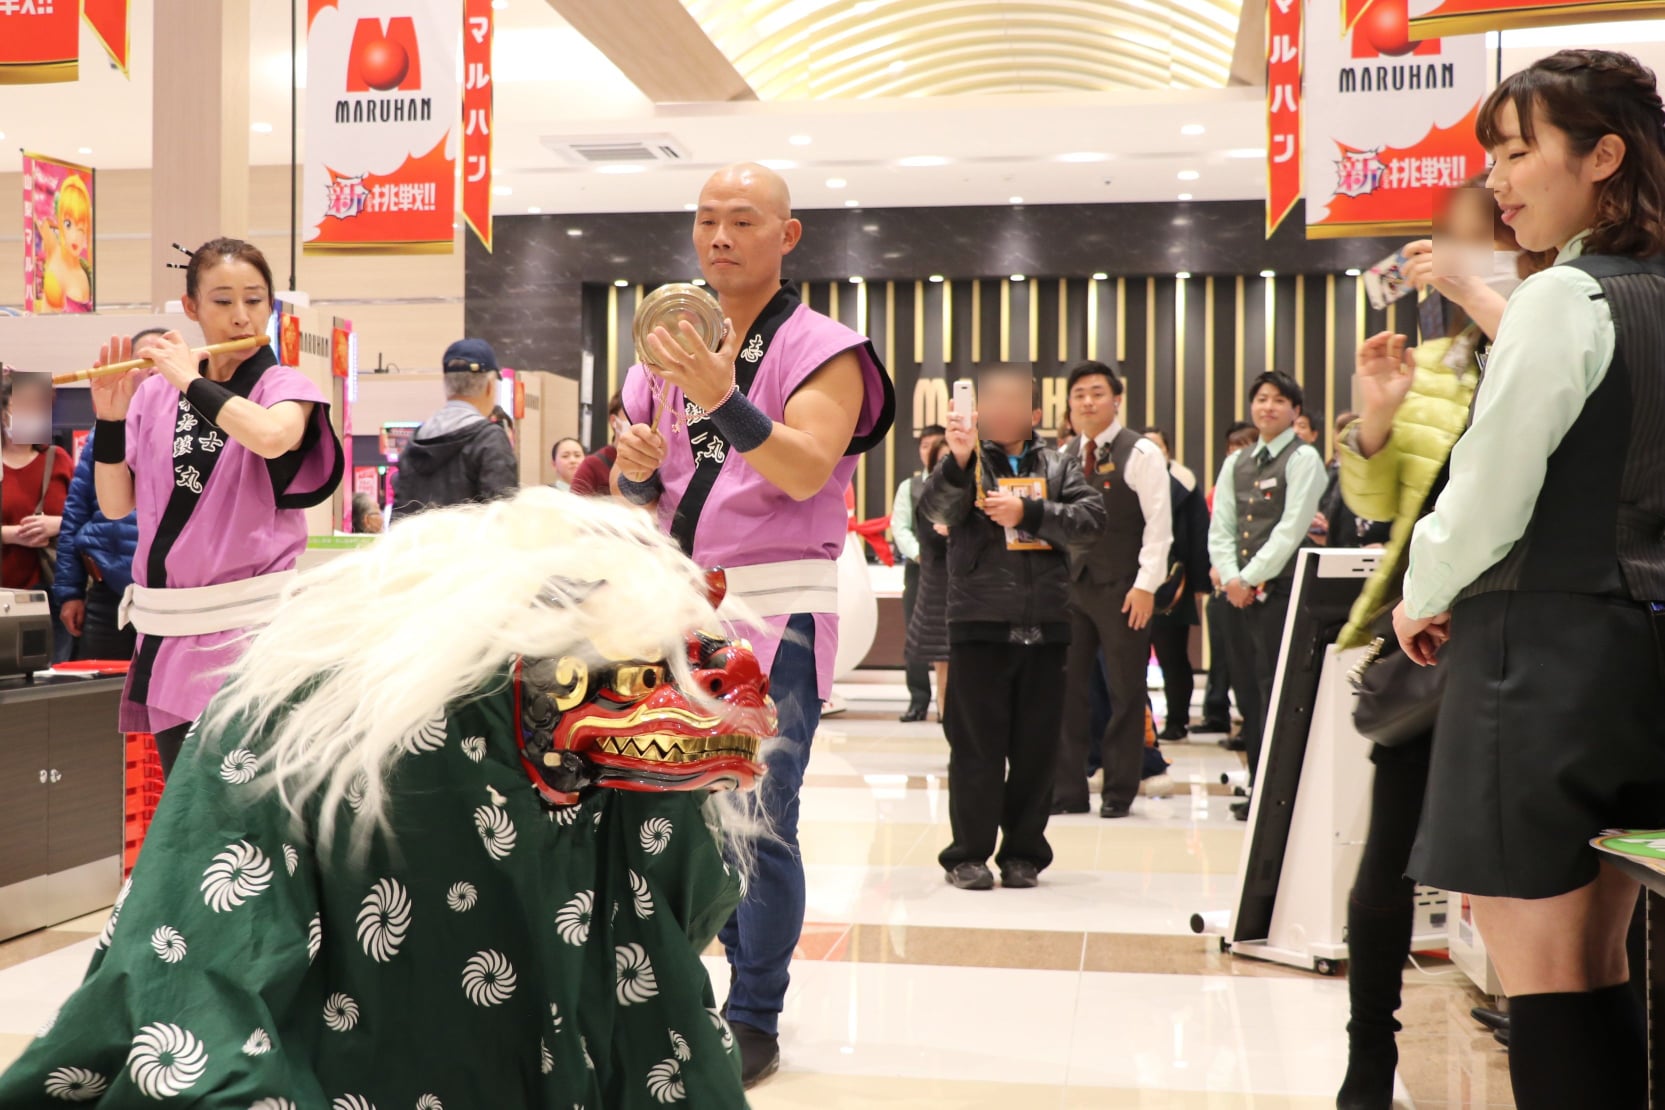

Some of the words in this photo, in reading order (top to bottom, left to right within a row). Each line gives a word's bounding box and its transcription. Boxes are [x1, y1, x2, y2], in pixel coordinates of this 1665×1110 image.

[1338, 63, 1454, 93] MARUHAN
[335, 98, 431, 123] MARUHAN
[466, 16, 490, 182] マルハン
